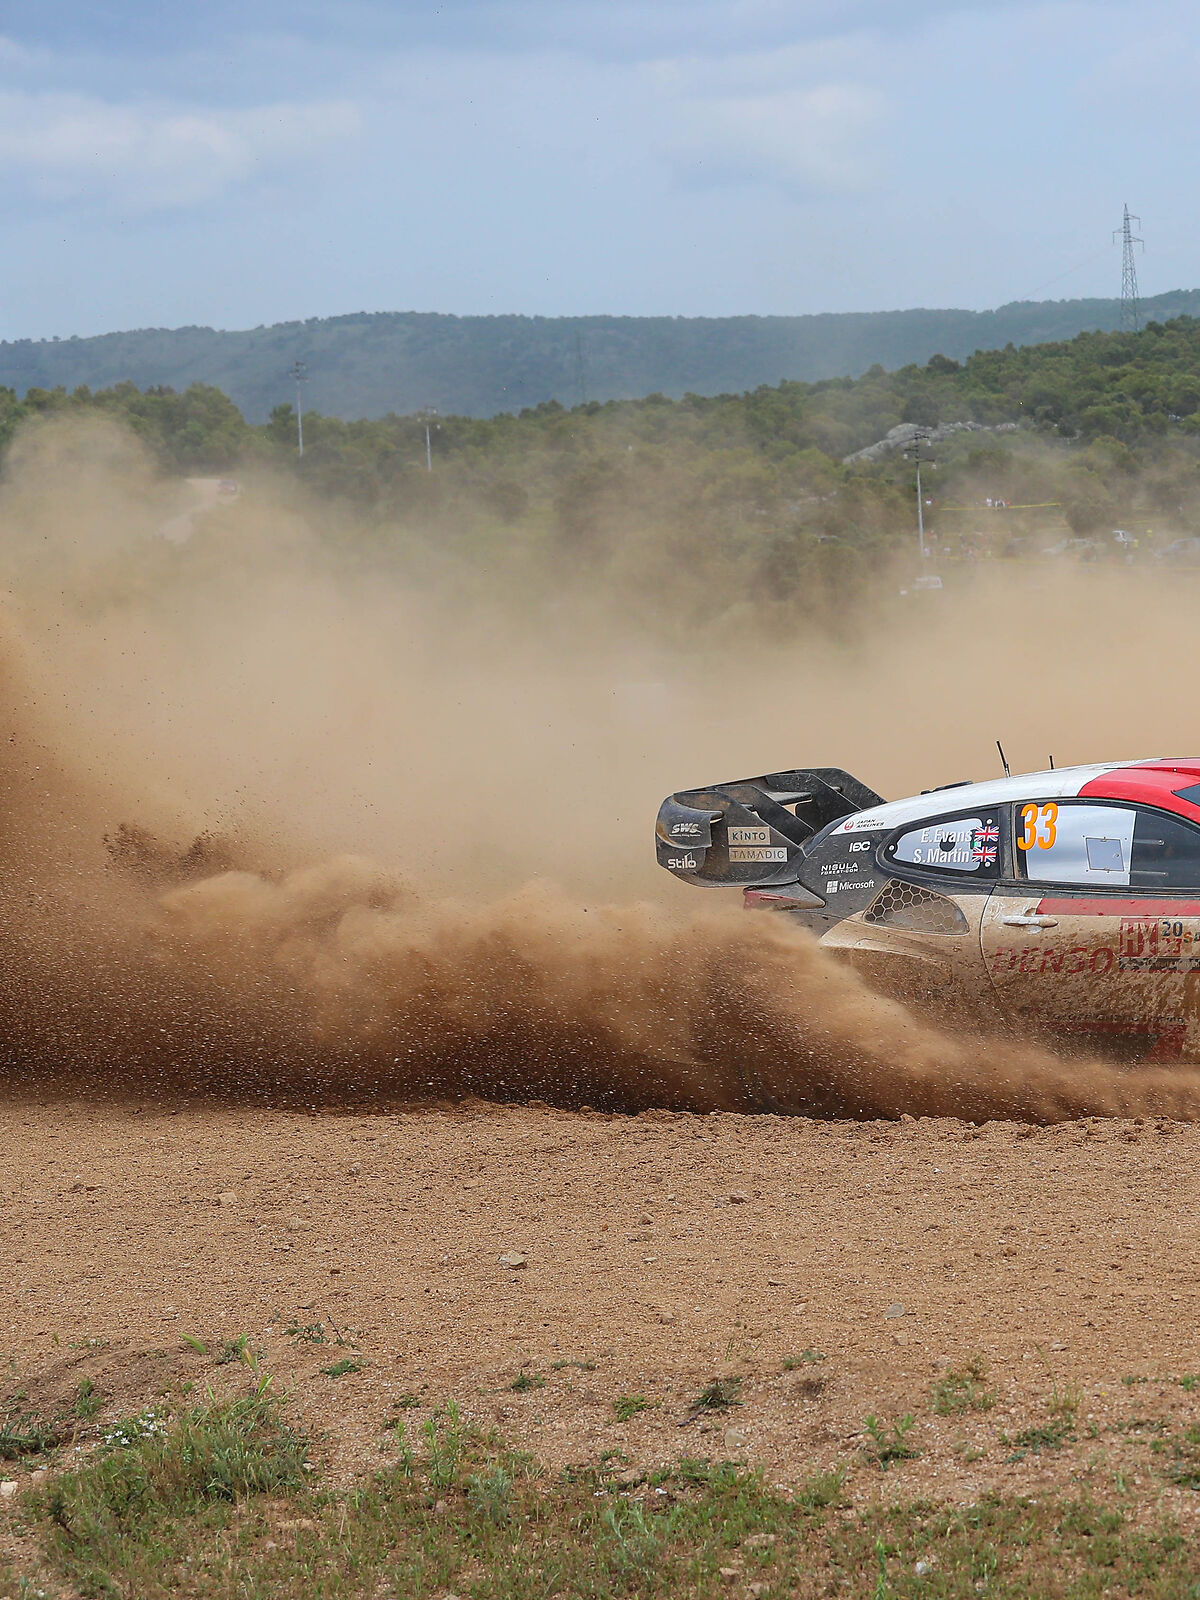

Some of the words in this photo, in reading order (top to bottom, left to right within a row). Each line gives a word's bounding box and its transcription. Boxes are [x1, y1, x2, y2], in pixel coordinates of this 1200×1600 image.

[856, 821, 885, 829] AIRLINES
[1017, 802, 1059, 851] 33
[921, 828, 973, 844] E.Evans
[667, 851, 697, 869] Stilo
[731, 850, 785, 860] TAMADIC
[913, 847, 970, 864] S.Martin
[821, 862, 859, 872] NISULA
[839, 879, 875, 891] Microsoft
[1161, 921, 1183, 937] 20
[991, 946, 1115, 974] DENSO
